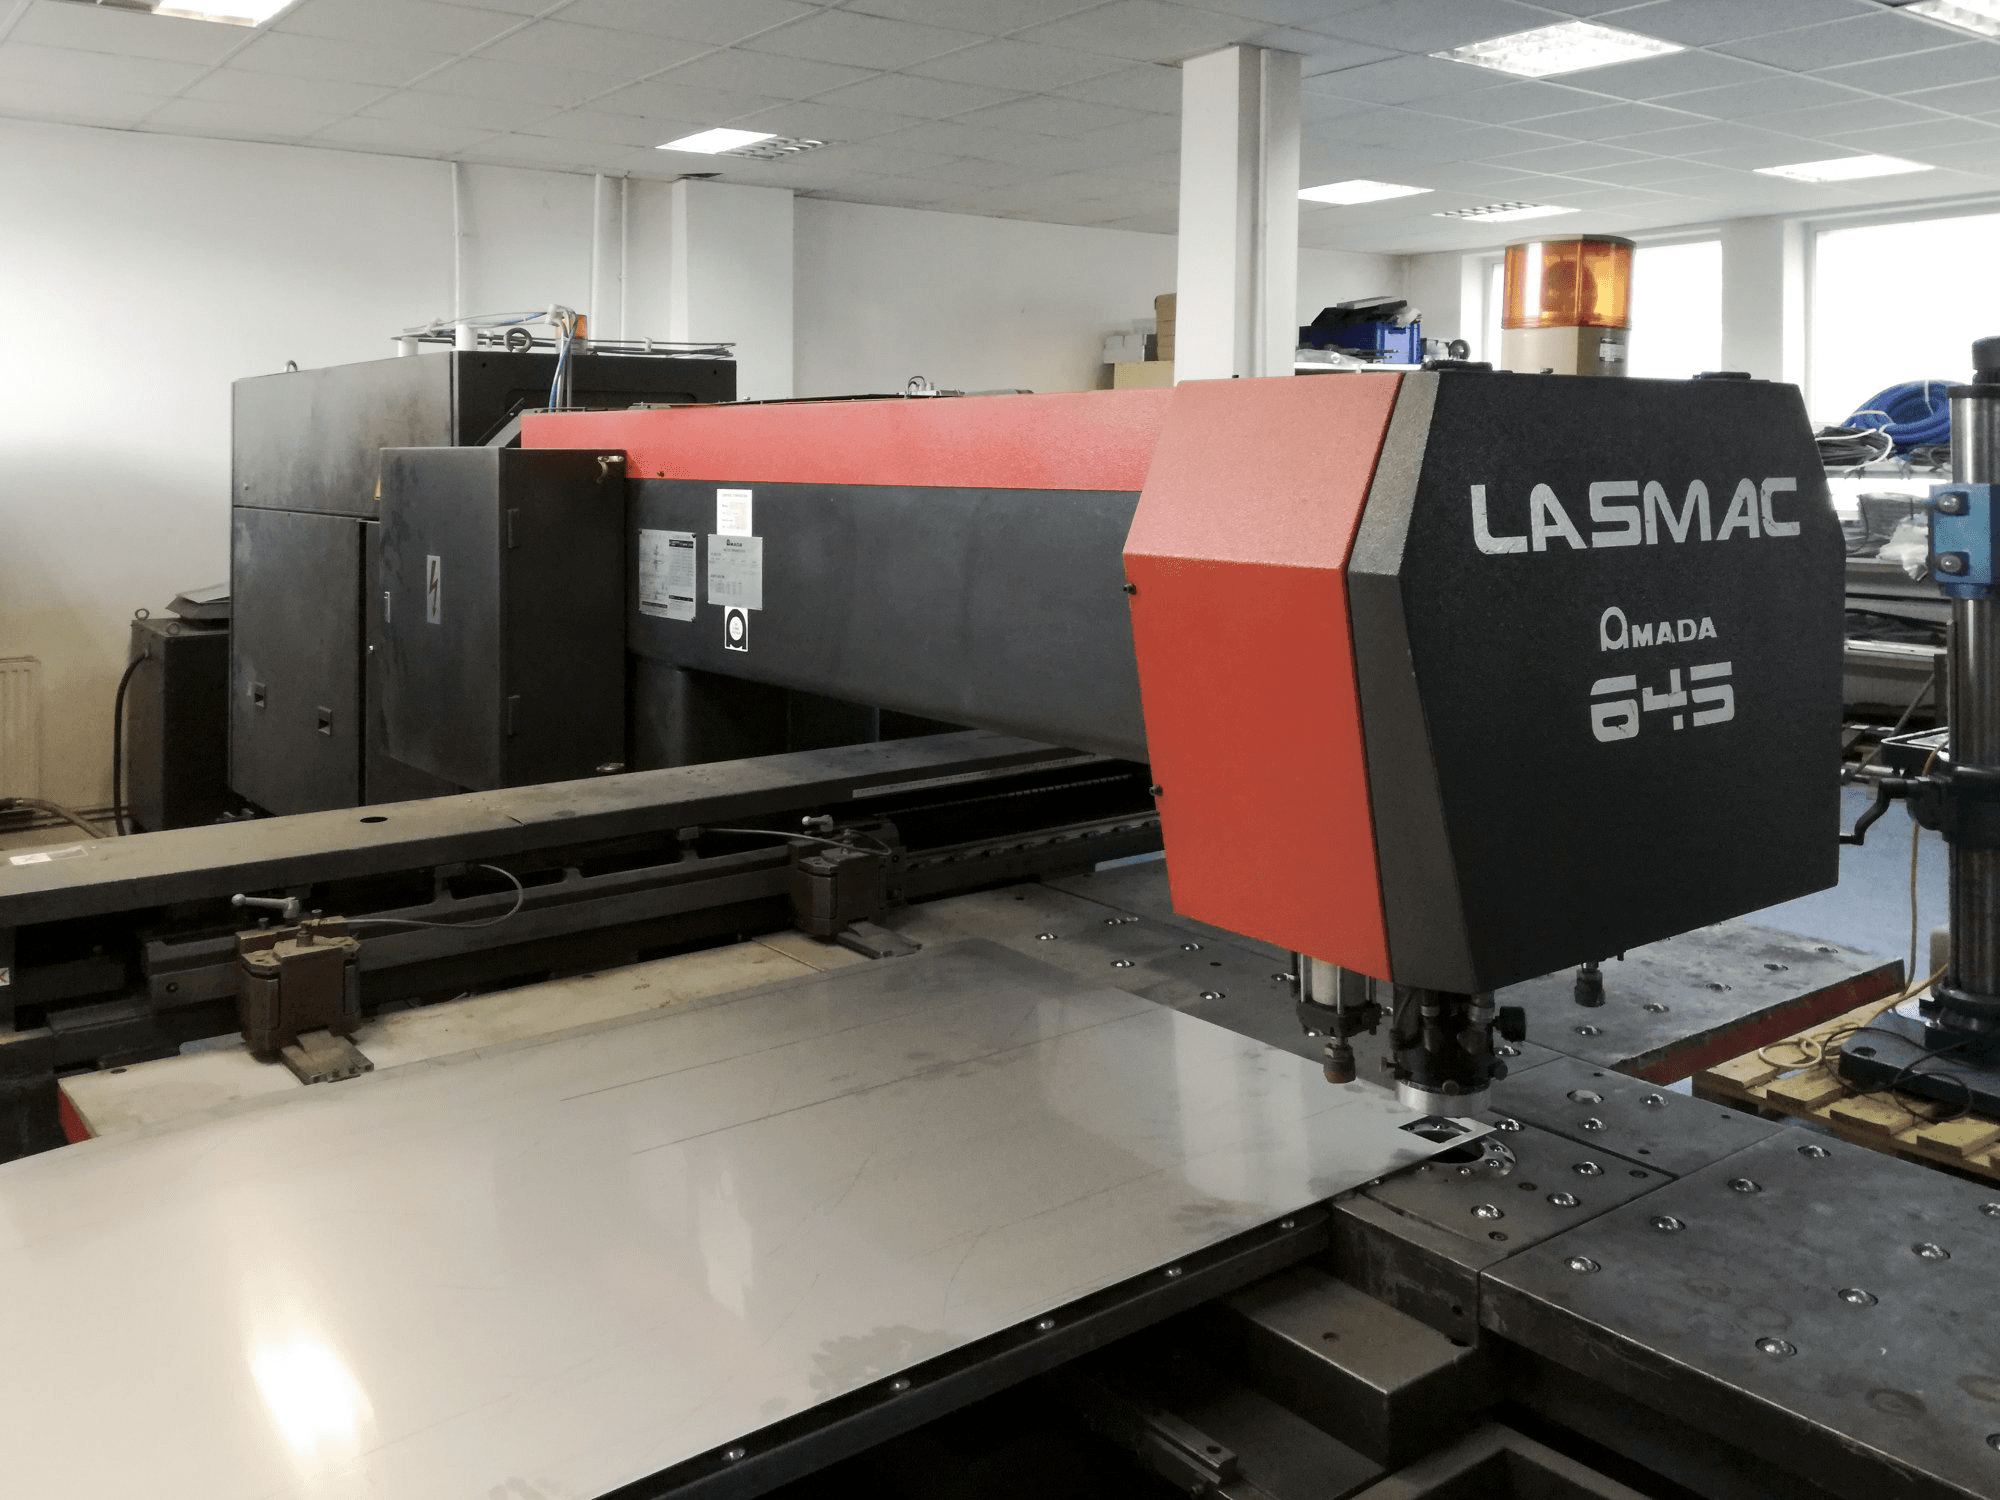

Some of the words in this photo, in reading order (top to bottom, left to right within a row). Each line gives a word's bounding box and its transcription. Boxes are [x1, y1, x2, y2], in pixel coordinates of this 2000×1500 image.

[1470, 476, 1801, 555] LASMAC
[1600, 606, 1718, 652] AMADA
[1590, 660, 1735, 743] 645
